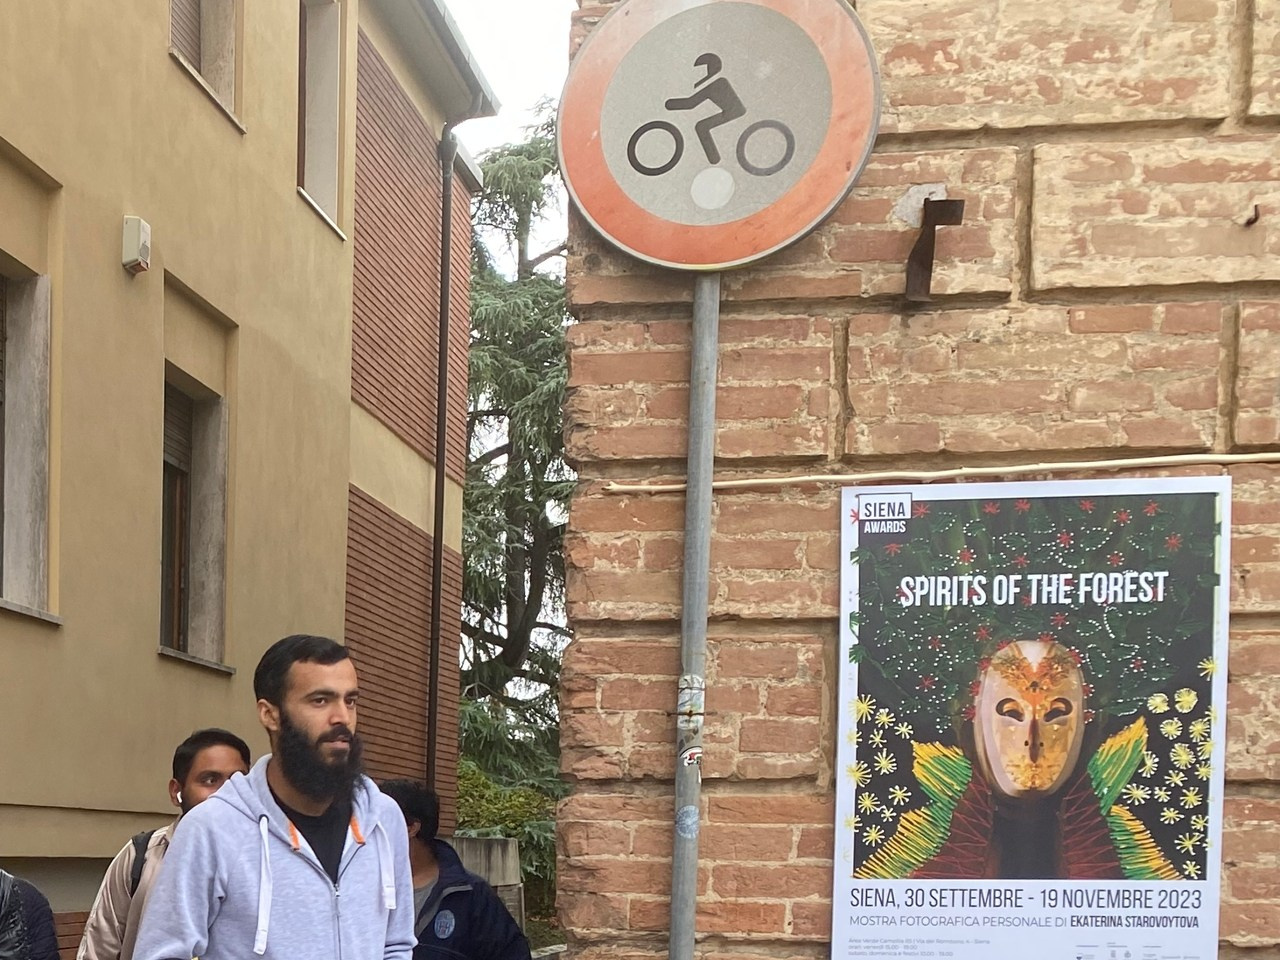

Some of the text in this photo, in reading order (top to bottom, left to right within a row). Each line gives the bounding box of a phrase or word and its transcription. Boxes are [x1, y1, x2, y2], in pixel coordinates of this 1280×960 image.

[864, 502, 906, 518] SIENA
[863, 520, 907, 534] AWARDS
[900, 571, 1170, 607] SPIRITS OF THE FOREST
[850, 888, 900, 909] SIENA,
[904, 888, 925, 908] 30
[928, 888, 1024, 908] SETTEMBRE
[1040, 889, 1058, 908] 19
[1062, 889, 1154, 909] NOVEMBRE
[1158, 889, 1202, 909] 2023
[849, 915, 1200, 929] MOSTRA FOTOGRAFICA PERSONALE DI EKATERINA STAROVOYTOVA
